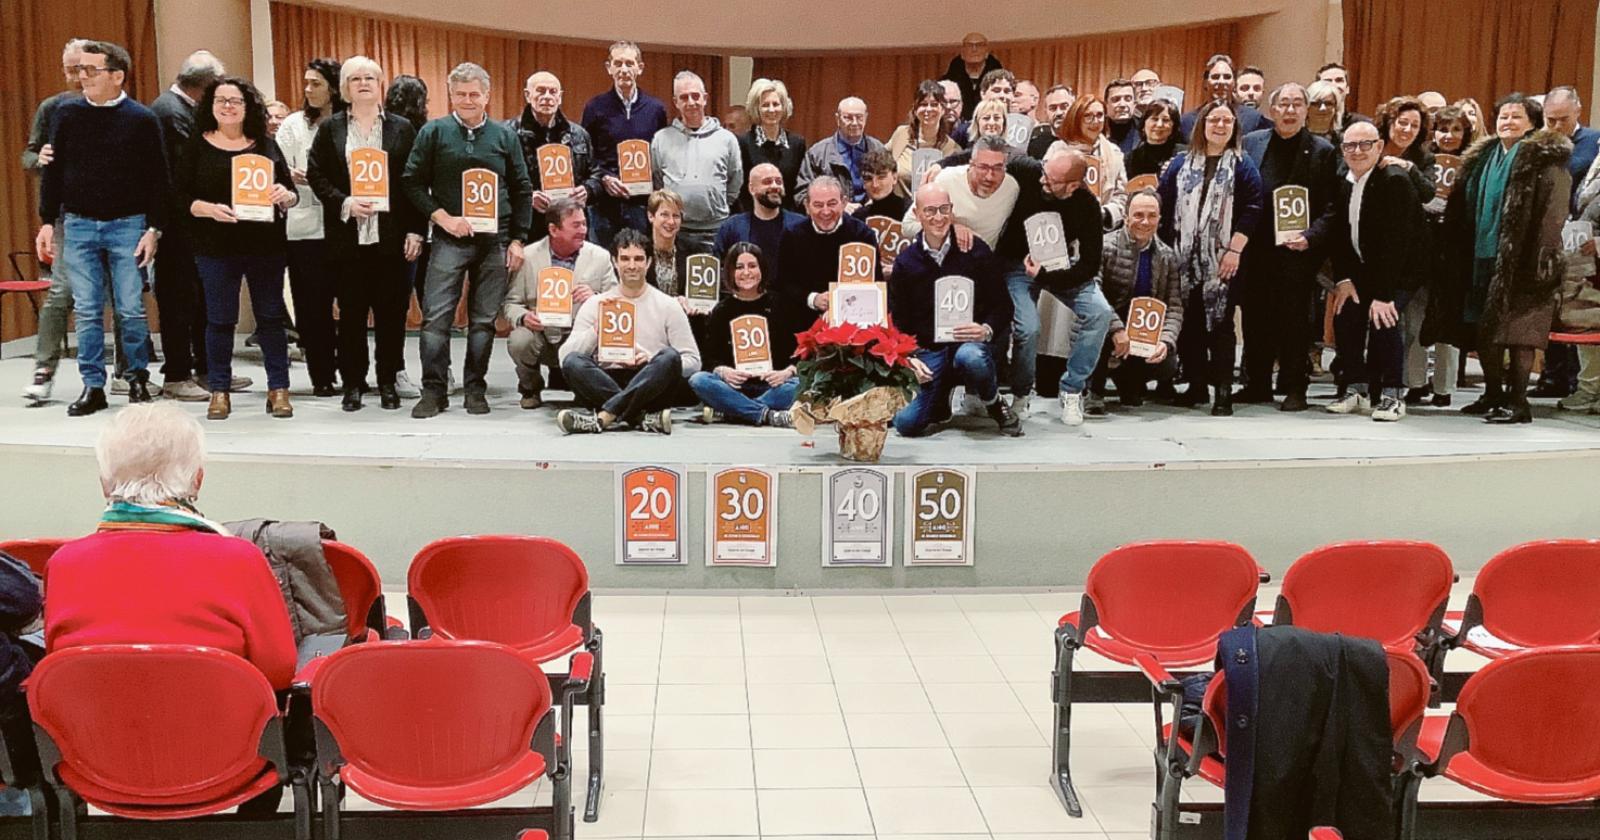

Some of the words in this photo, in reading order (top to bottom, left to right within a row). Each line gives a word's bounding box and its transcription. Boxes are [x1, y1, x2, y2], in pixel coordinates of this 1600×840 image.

[355, 160, 383, 182] 20
[543, 155, 568, 177] 20
[622, 150, 647, 170] 20
[238, 167, 268, 191] 20
[1434, 165, 1456, 187] 30
[466, 181, 493, 204] 30
[1279, 197, 1305, 218] 50
[1034, 224, 1059, 246] 40
[690, 265, 716, 287] 50
[843, 255, 871, 277] 30
[541, 278, 569, 299] 20
[940, 290, 969, 312] 40
[603, 311, 632, 334] 30
[1131, 308, 1160, 331] 30
[736, 327, 764, 350] 30
[630, 486, 672, 520] 20
[720, 487, 764, 521] 30
[837, 488, 880, 521] 40
[919, 487, 961, 520] 50
